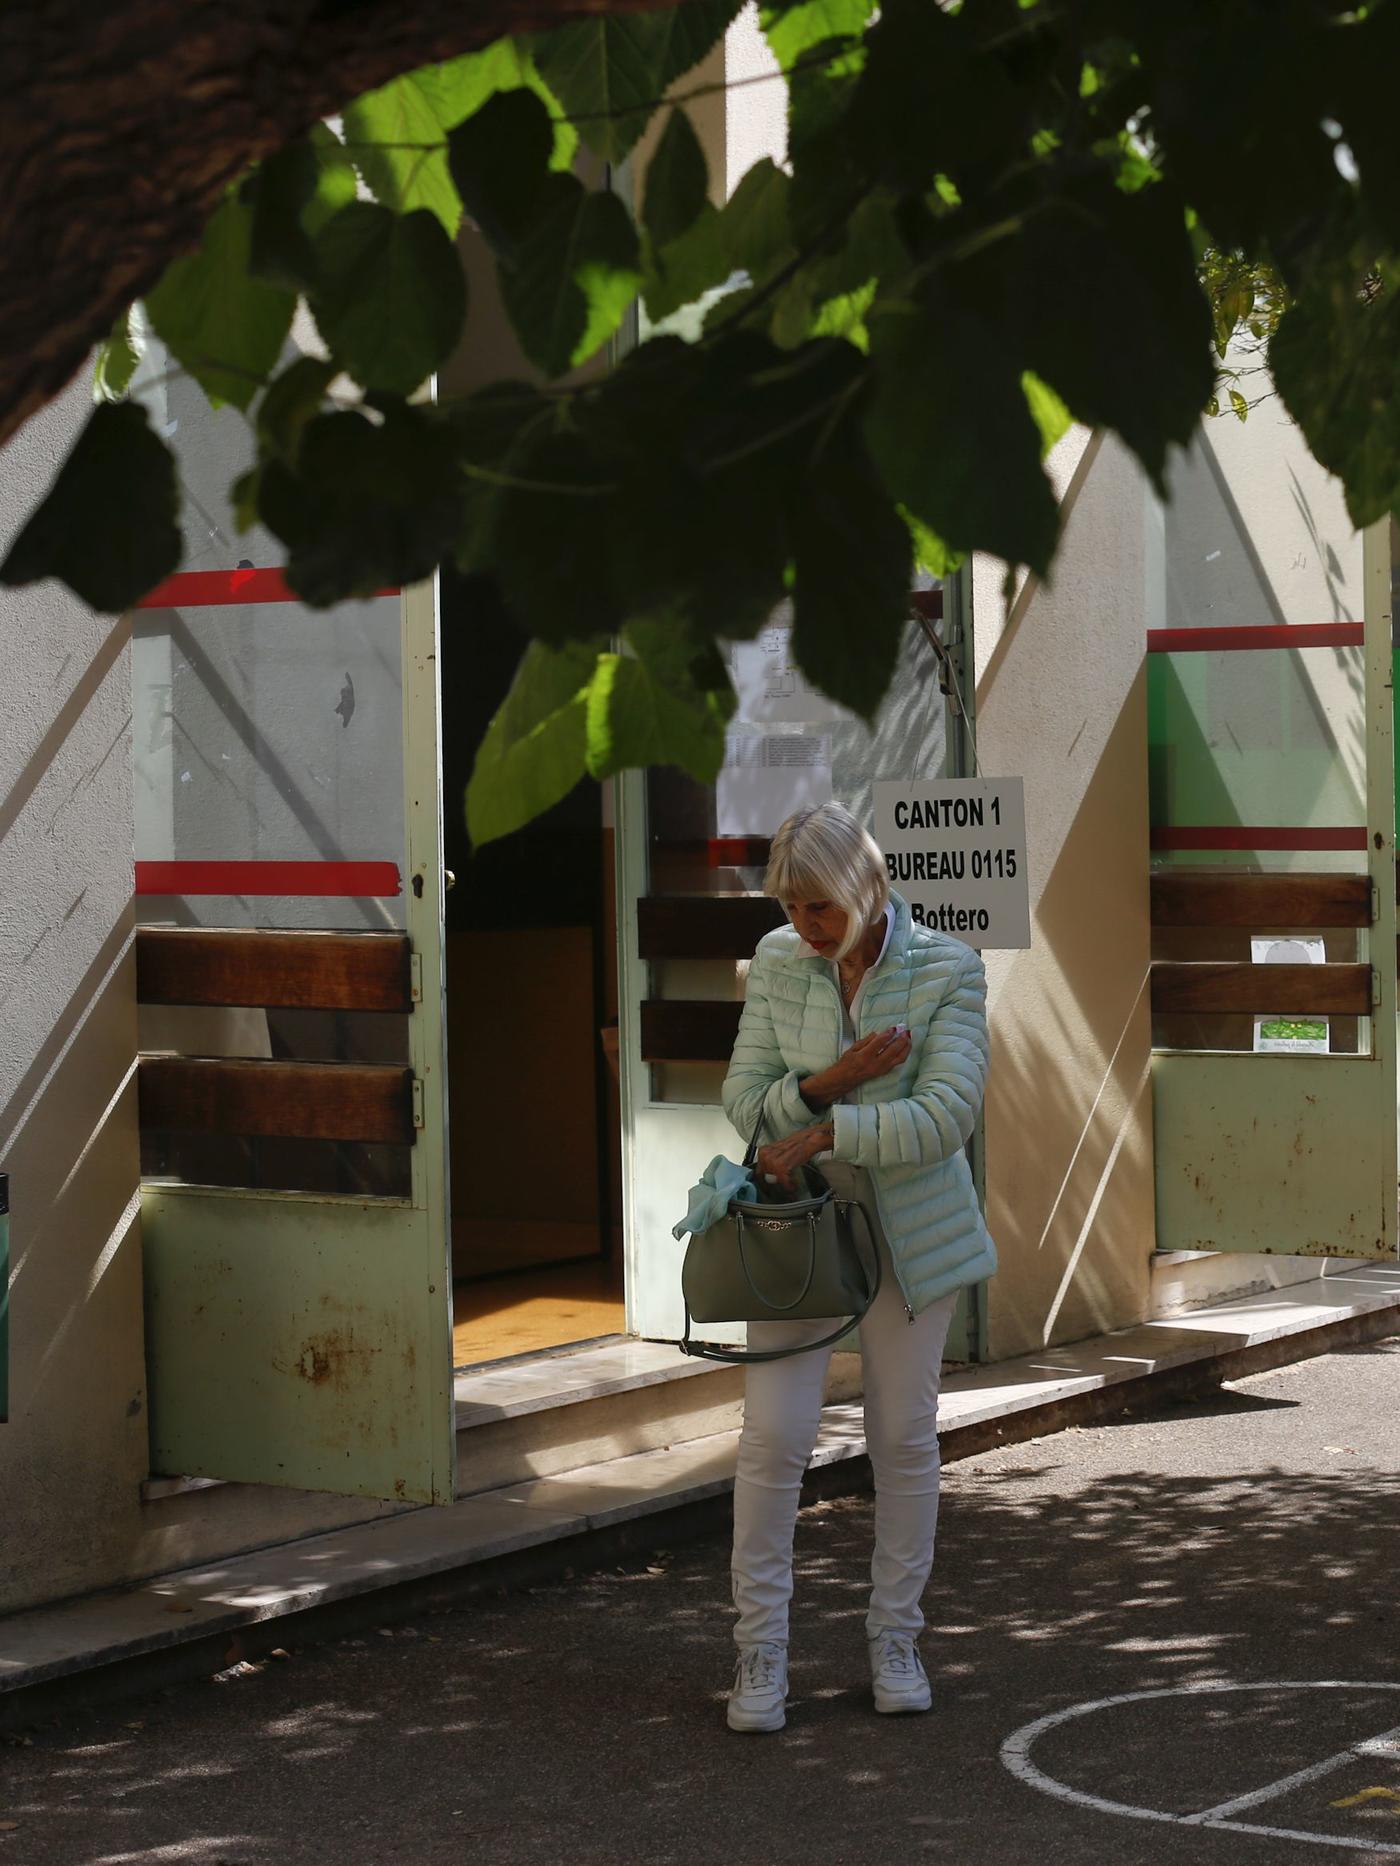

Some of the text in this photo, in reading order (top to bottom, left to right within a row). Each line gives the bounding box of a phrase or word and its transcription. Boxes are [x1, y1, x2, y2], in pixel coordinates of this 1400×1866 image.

[894, 796, 1000, 829] CANTON 1
[885, 849, 1017, 881] BUREAU 0115
[911, 903, 989, 932] Bottero
